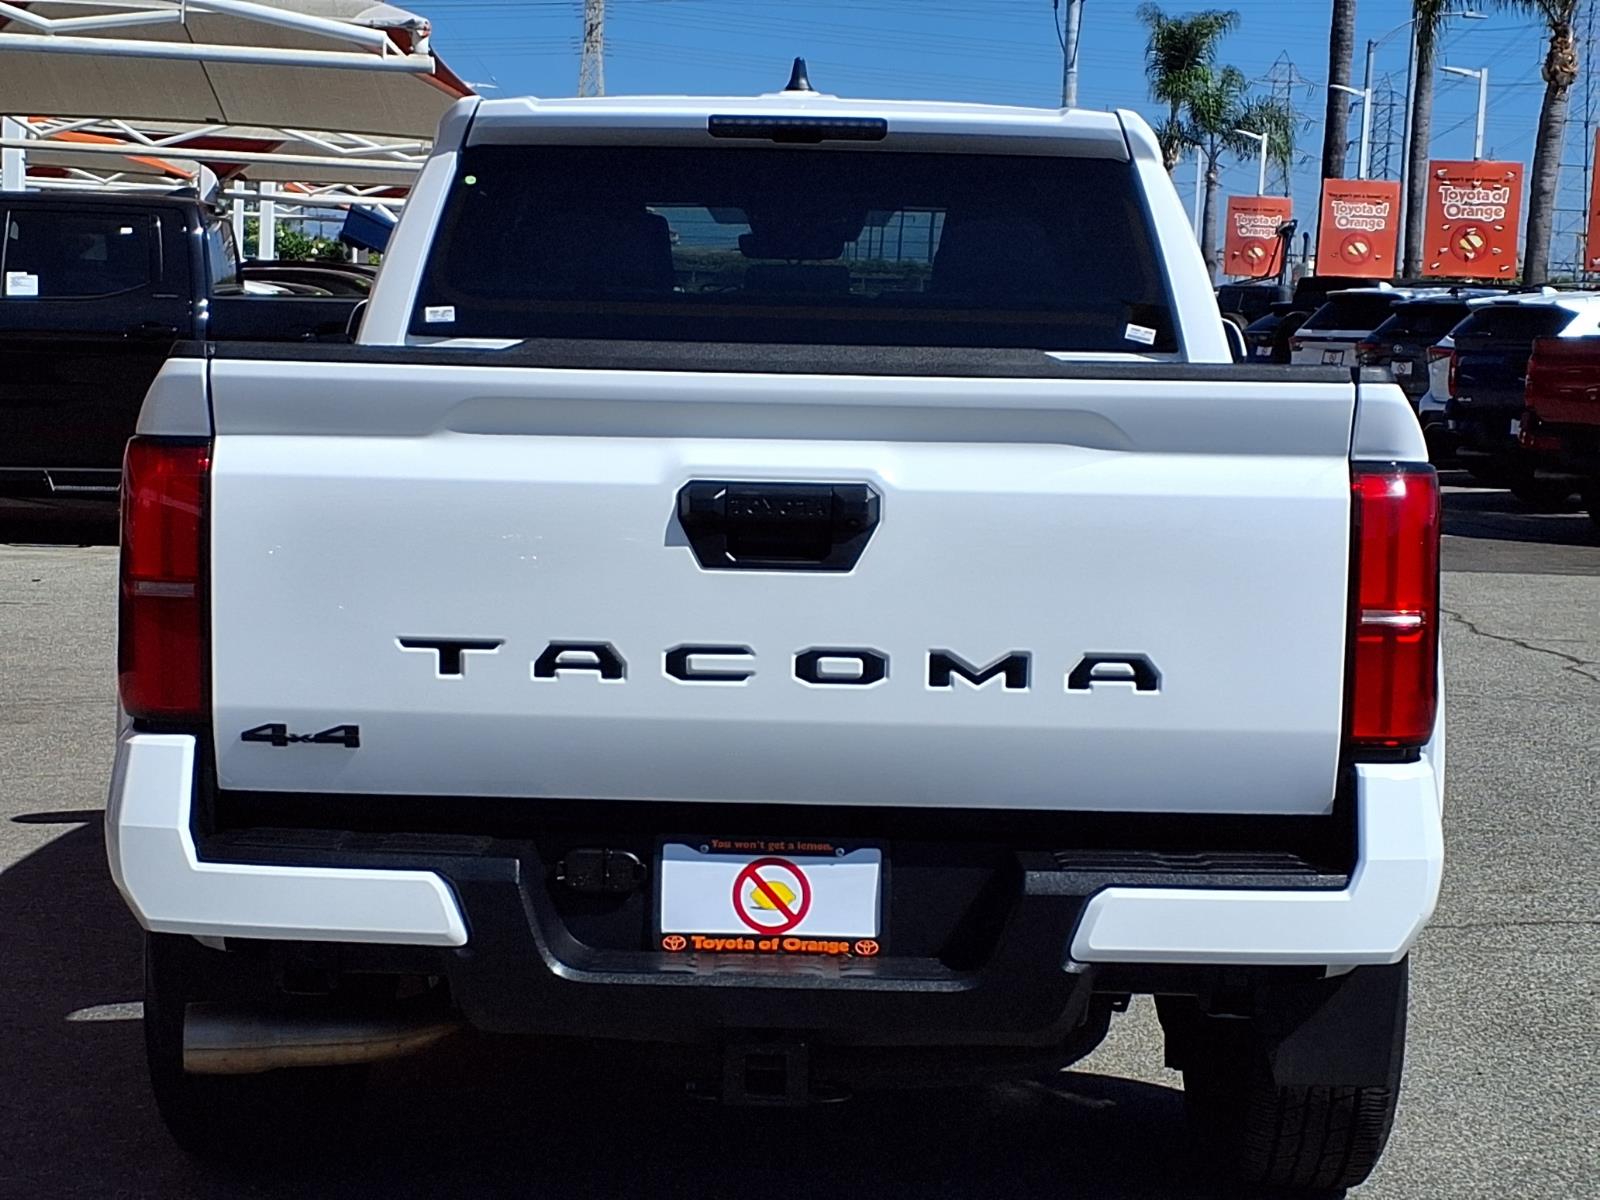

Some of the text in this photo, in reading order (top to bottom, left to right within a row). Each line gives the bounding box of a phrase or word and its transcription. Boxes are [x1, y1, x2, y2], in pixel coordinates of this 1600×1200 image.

[1439, 187, 1509, 204] Toyota of
[1332, 201, 1389, 216] Toyota of
[1444, 203, 1505, 221] Orange
[1235, 213, 1282, 227] Toyota of
[1336, 215, 1385, 231] Orange
[394, 635, 1163, 697] TACOMA
[241, 723, 360, 748] 4x4
[711, 839, 833, 852] You won't get a lemon.
[691, 935, 849, 954] Toyota of Orange
